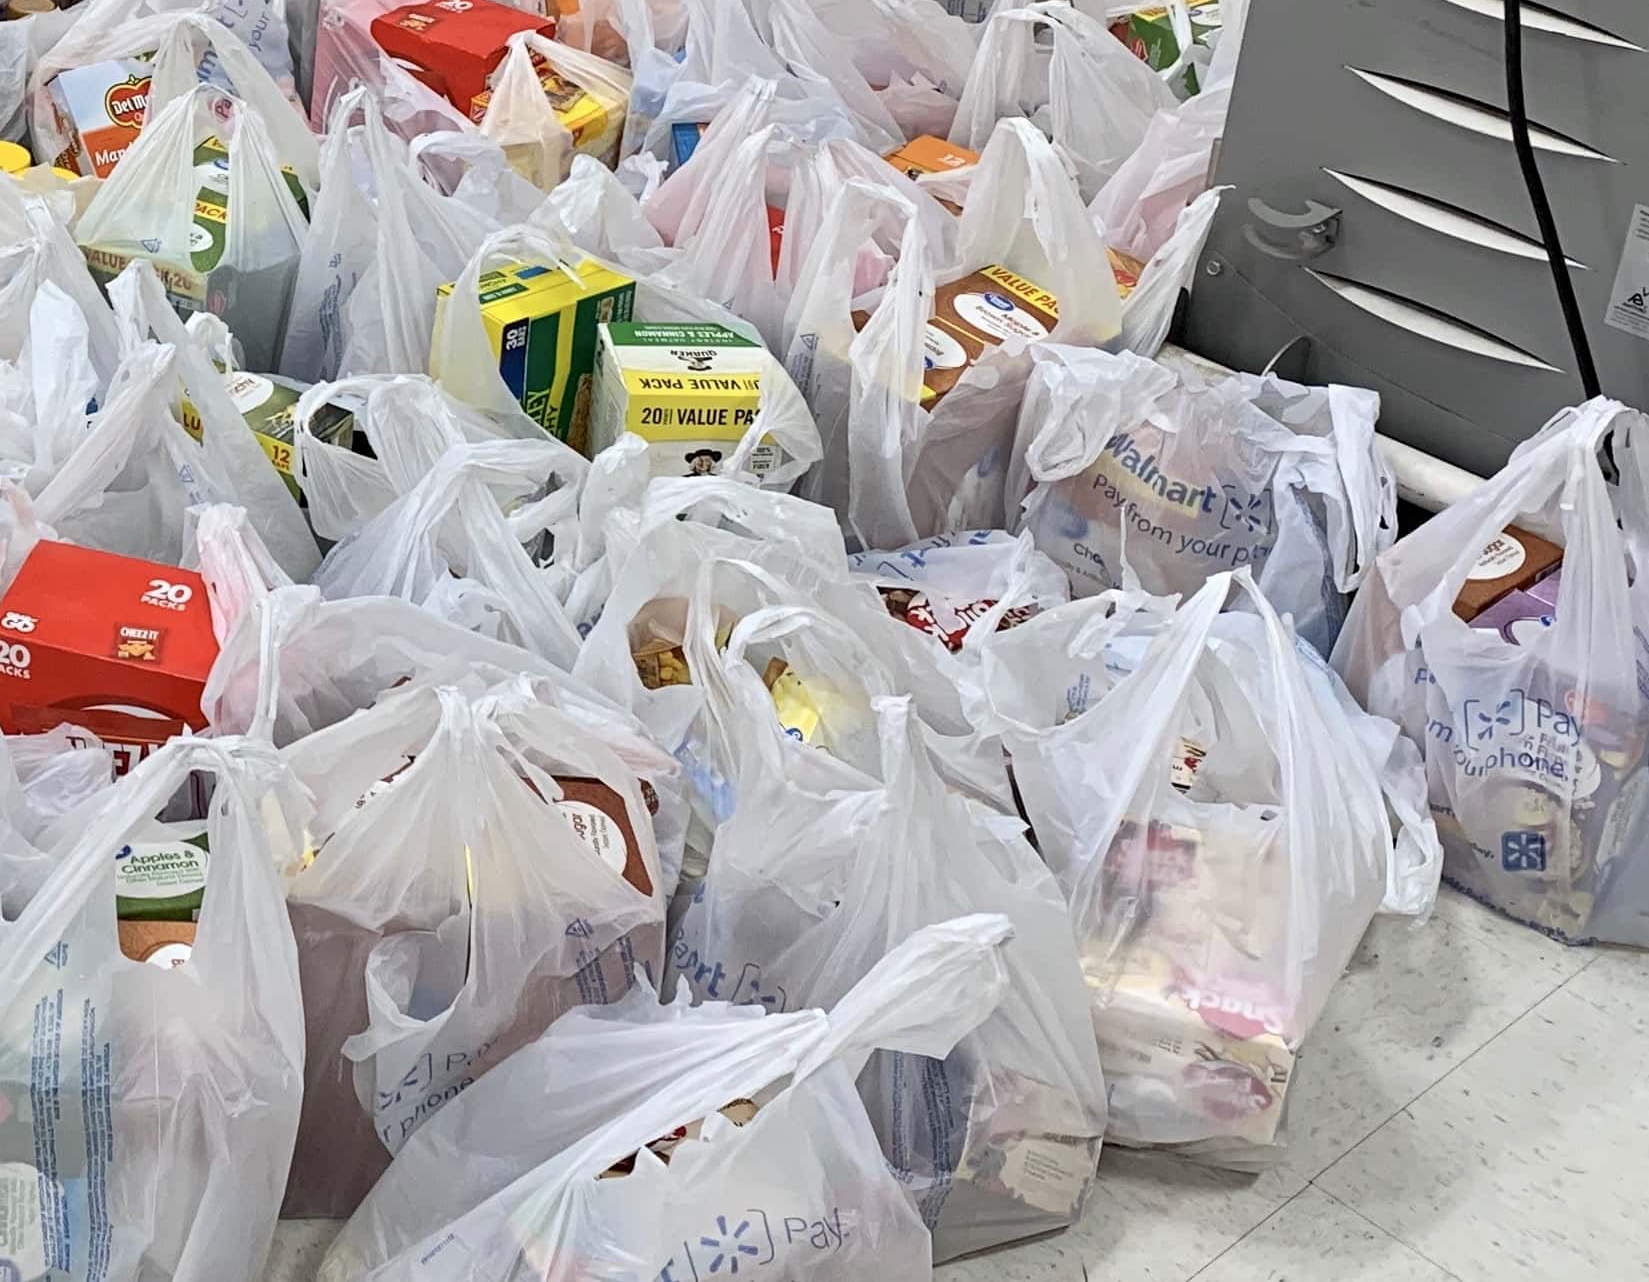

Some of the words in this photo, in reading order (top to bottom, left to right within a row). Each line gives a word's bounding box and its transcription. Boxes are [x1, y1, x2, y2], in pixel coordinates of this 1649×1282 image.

[248, 12, 271, 53] your
[111, 97, 132, 115] Del
[992, 268, 1040, 297] VALUE
[1035, 294, 1059, 314] PA
[506, 328, 518, 350] 30
[639, 377, 683, 390] PACK
[688, 378, 741, 391] VALUE
[641, 407, 663, 425] 20
[677, 408, 728, 426] VALUE
[734, 408, 760, 426] PA
[272, 445, 290, 464] 12
[1104, 433, 1217, 513] Walmart
[1093, 473, 1127, 508] Pay
[1128, 502, 1173, 545] from
[1175, 534, 1231, 560] your
[145, 579, 192, 604] 20
[140, 595, 187, 611] PACKS
[1454, 745, 1484, 777] our
[1485, 747, 1569, 782] phone.
[131, 851, 181, 864] Apples
[184, 850, 194, 858] &
[121, 860, 199, 874] Cinnamon
